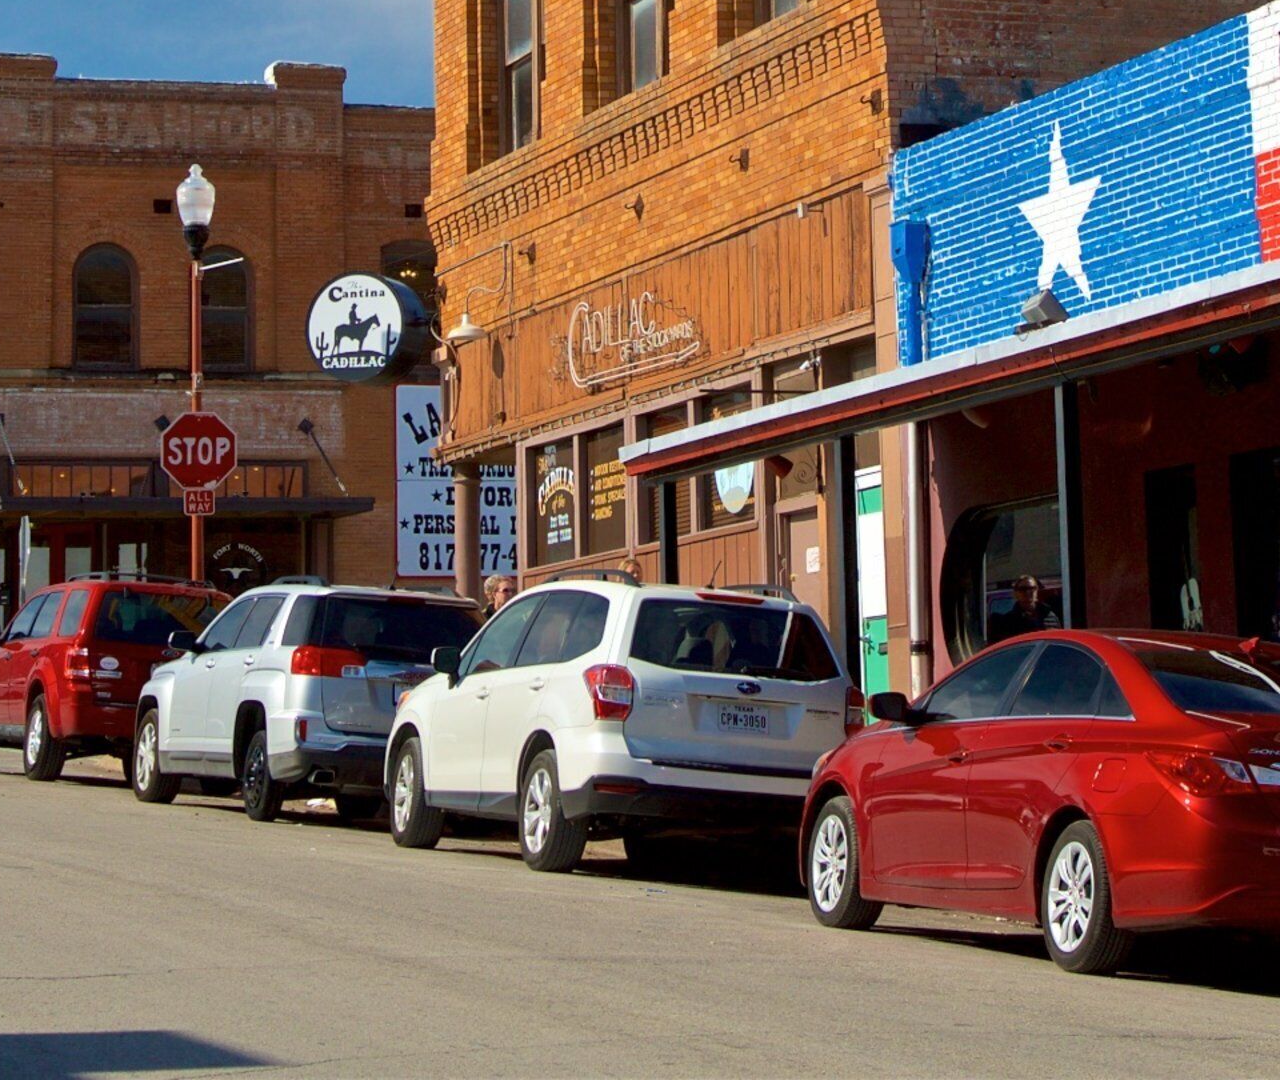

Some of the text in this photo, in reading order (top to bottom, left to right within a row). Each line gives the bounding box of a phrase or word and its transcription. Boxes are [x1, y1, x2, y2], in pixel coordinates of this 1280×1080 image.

[328, 286, 386, 303] Cantina
[567, 291, 665, 380] CADILLAC
[322, 355, 386, 369] CADILLAC
[168, 436, 231, 466] STOP
[188, 492, 211, 502] ALL
[188, 502, 212, 513] WAY
[212, 542, 263, 563] FORT WORTH
